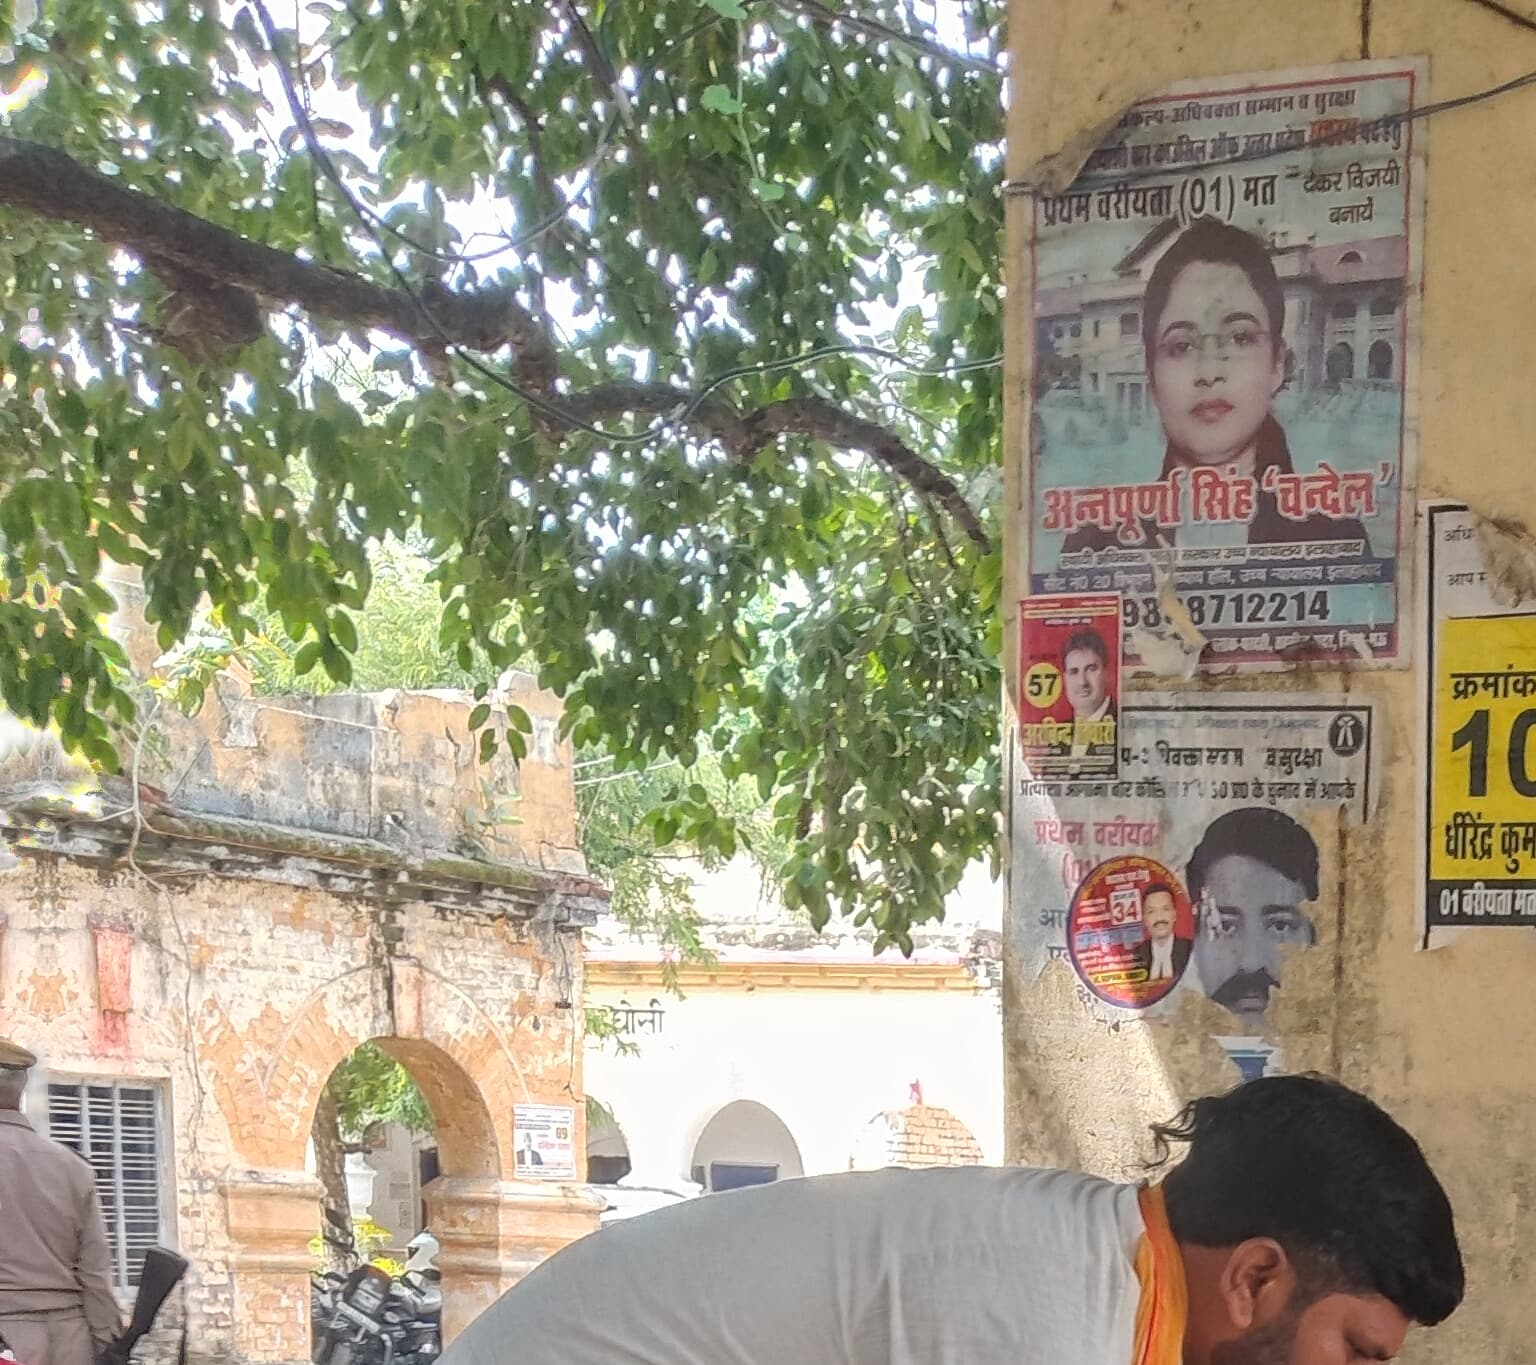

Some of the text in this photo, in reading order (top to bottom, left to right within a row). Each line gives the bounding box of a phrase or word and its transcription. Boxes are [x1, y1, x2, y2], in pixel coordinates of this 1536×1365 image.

[1242, 174, 1279, 207] मत
[1042, 468, 1182, 541] अन्नपूर्णा
[1192, 467, 1255, 523] सिंह
[1028, 673, 1058, 697] 57
[1112, 901, 1139, 923] 34
